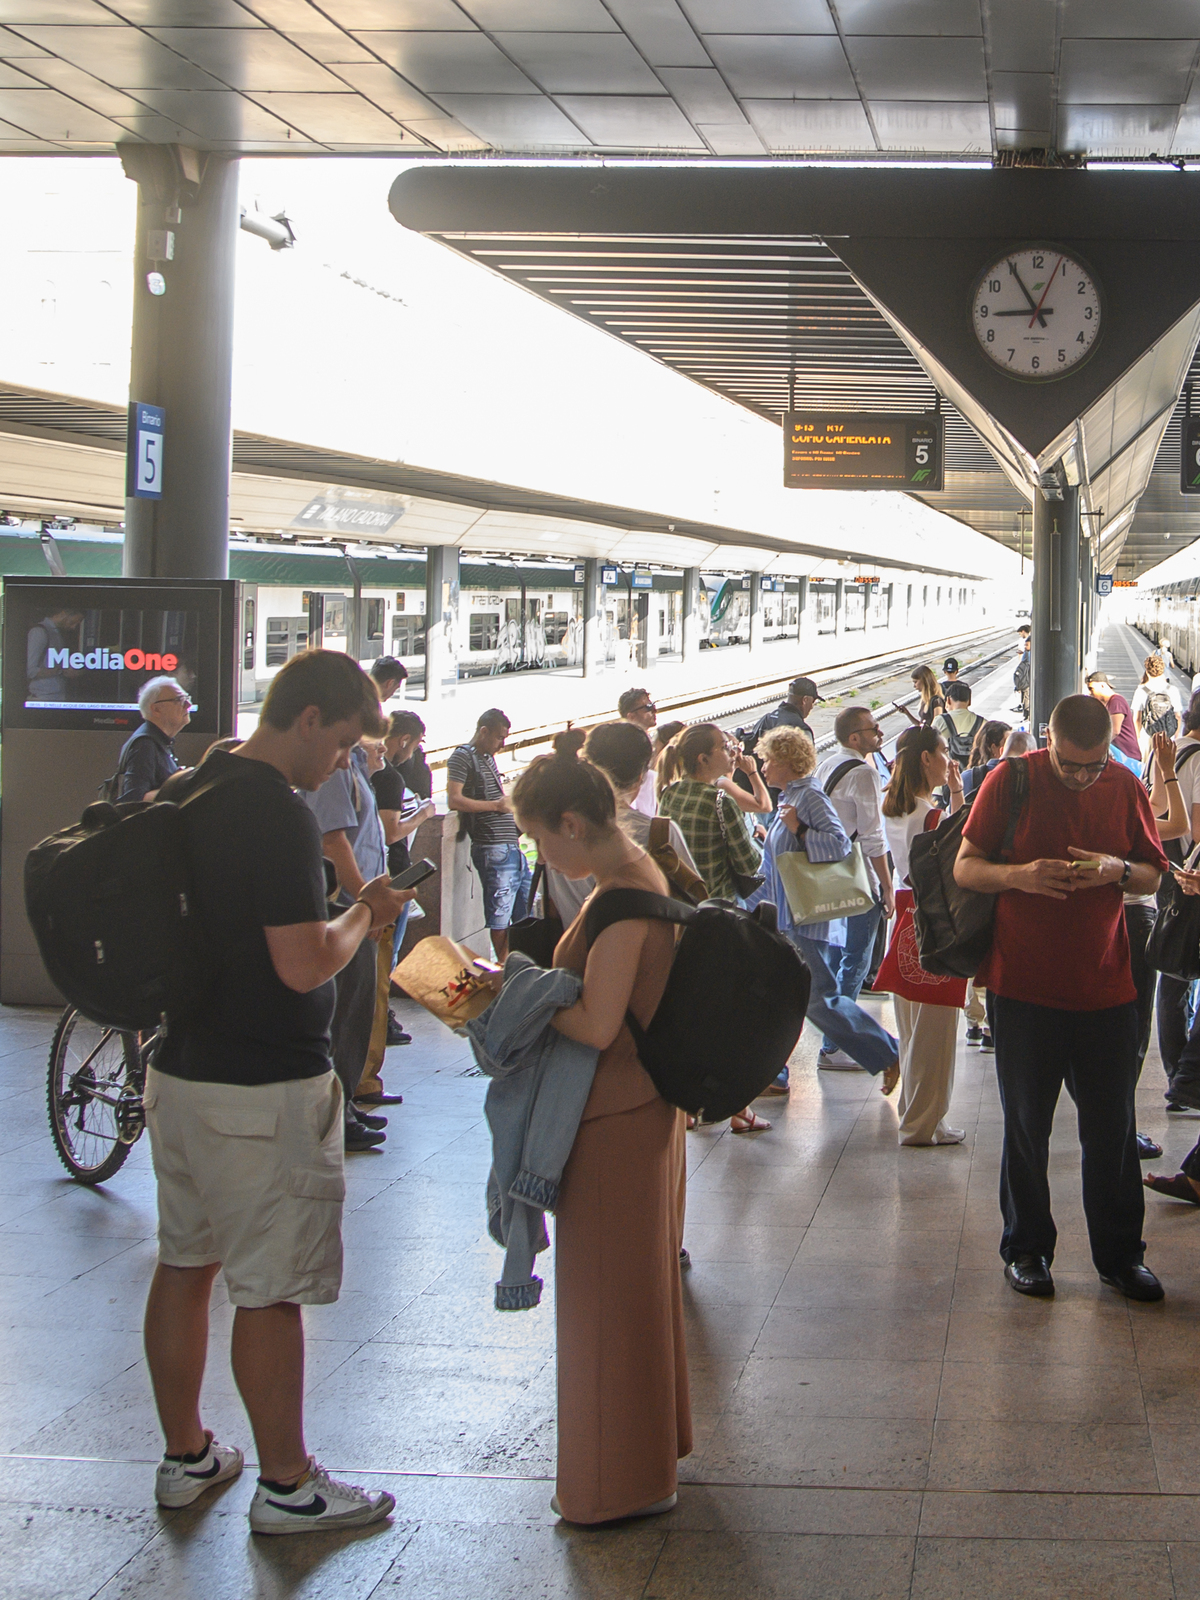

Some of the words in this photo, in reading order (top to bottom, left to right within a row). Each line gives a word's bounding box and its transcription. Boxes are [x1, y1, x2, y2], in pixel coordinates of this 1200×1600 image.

[1032, 256, 1044, 269] 12
[989, 280, 1001, 293] 10
[1077, 281, 1086, 294] 2
[980, 305, 988, 318] 9
[1084, 307, 1093, 320] 3
[986, 329, 995, 342] 8
[1076, 331, 1085, 344] 4
[1007, 348, 1016, 362] 7
[1057, 349, 1066, 362] 5
[1031, 356, 1040, 369] 6
[142, 410, 161, 427] Binario
[915, 445, 929, 464] 5
[144, 439, 155, 484] 5
[1101, 581, 1108, 591] 6
[47, 648, 178, 671] MediaOne
[814, 897, 866, 913] MILANO
[161, 1466, 177, 1477] NIKE
